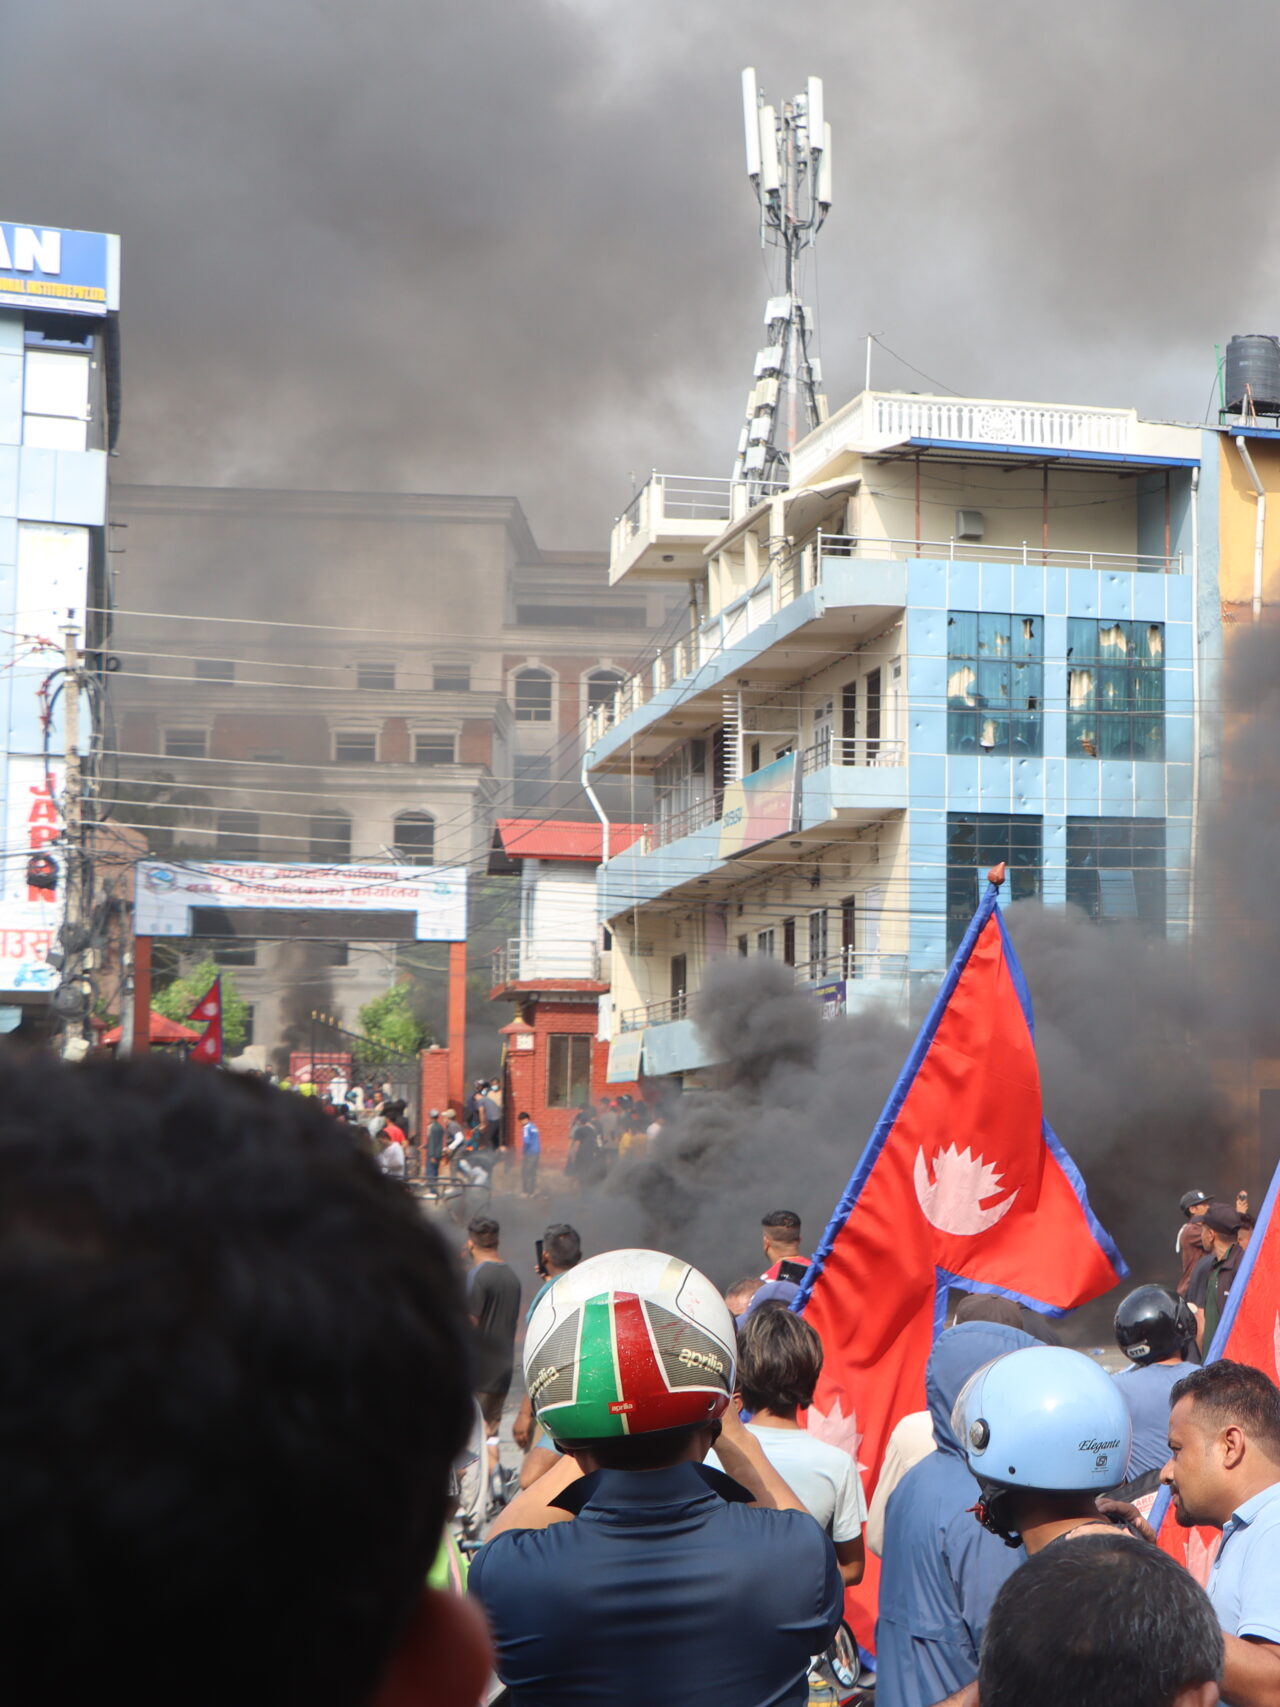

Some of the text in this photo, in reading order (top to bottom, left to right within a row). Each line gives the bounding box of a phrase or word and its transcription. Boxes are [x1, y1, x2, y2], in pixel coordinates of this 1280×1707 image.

[679, 1348, 724, 1375] aprilia
[611, 1402, 634, 1412] aprilia
[1078, 1438, 1121, 1454] Elegante
